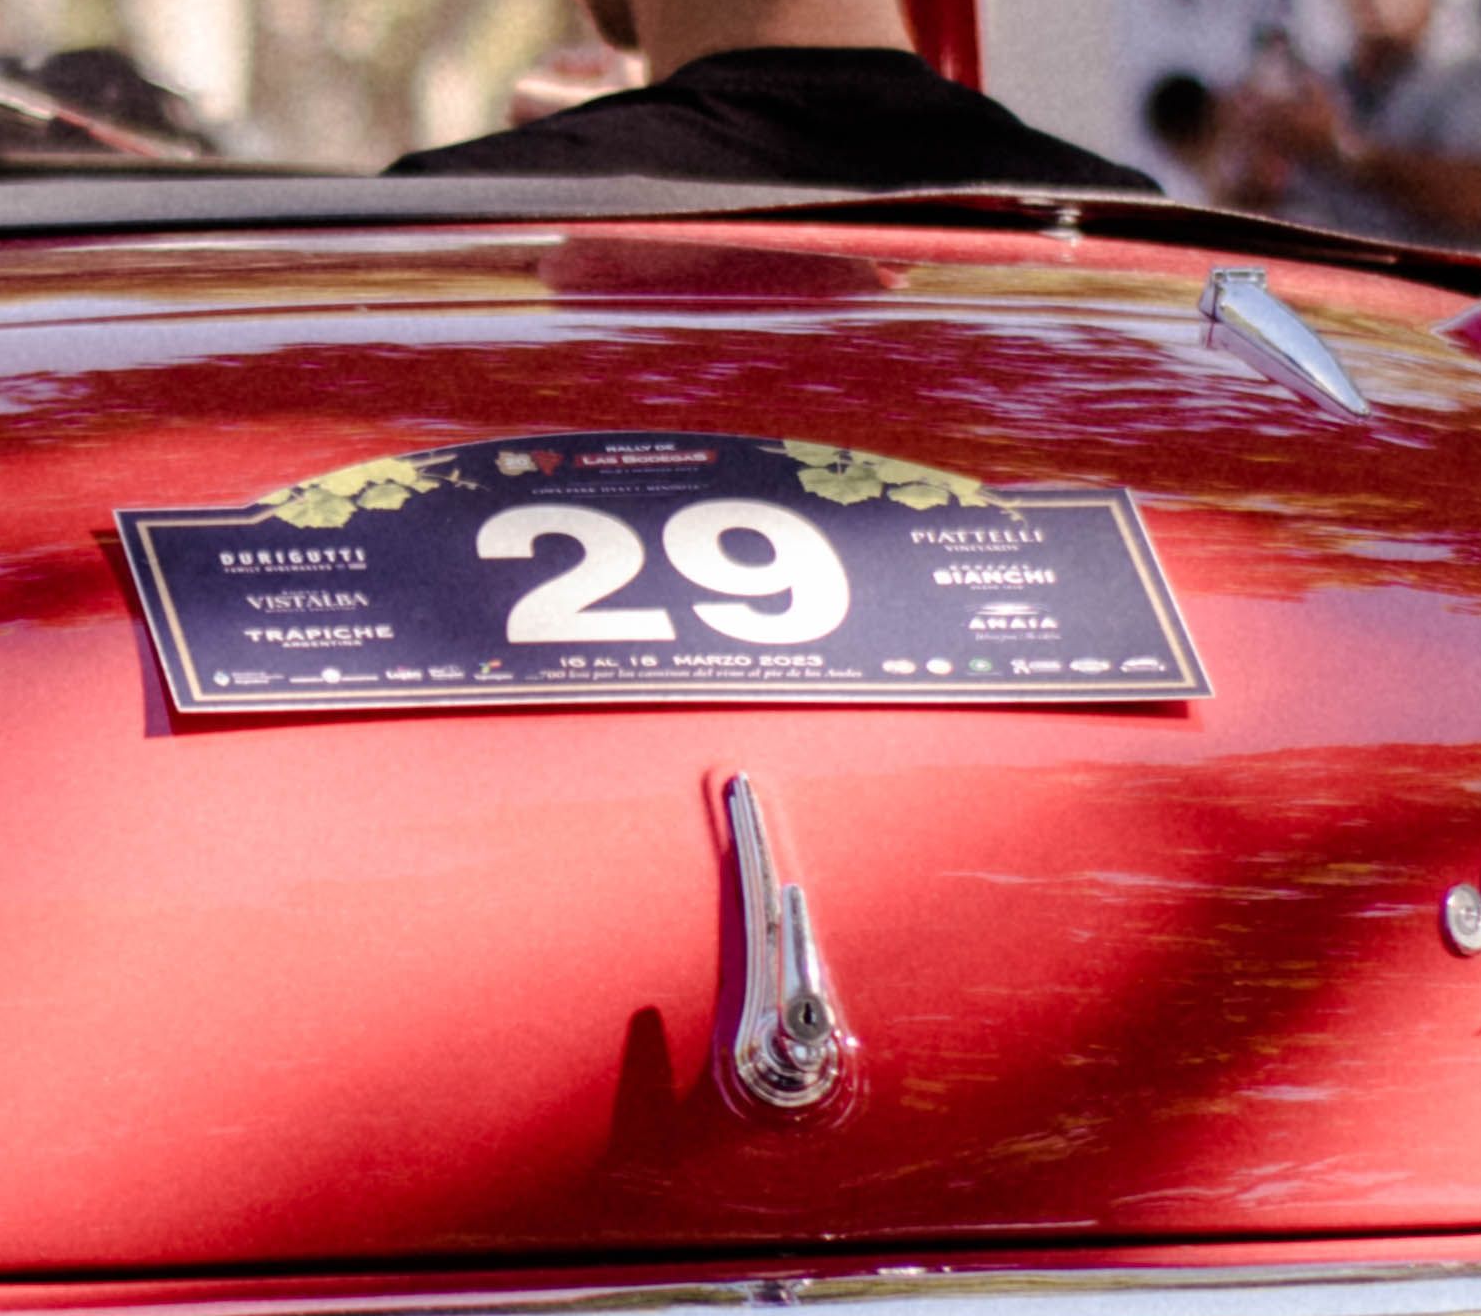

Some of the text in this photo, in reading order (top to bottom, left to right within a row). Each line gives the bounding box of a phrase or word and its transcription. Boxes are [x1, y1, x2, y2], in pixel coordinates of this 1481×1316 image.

[605, 444, 652, 452] RALLY
[582, 455, 618, 464] LAS
[910, 529, 1044, 544] PIATTELLI
[219, 548, 367, 566] DURIGUTTI
[476, 498, 850, 644] 29
[932, 570, 1056, 584] BIANCHI
[246, 592, 369, 610] VISTALBA
[244, 625, 394, 643] TRAPICHE
[593, 656, 619, 668] AL
[672, 654, 752, 666] MARZO
[759, 654, 824, 666] 2023
